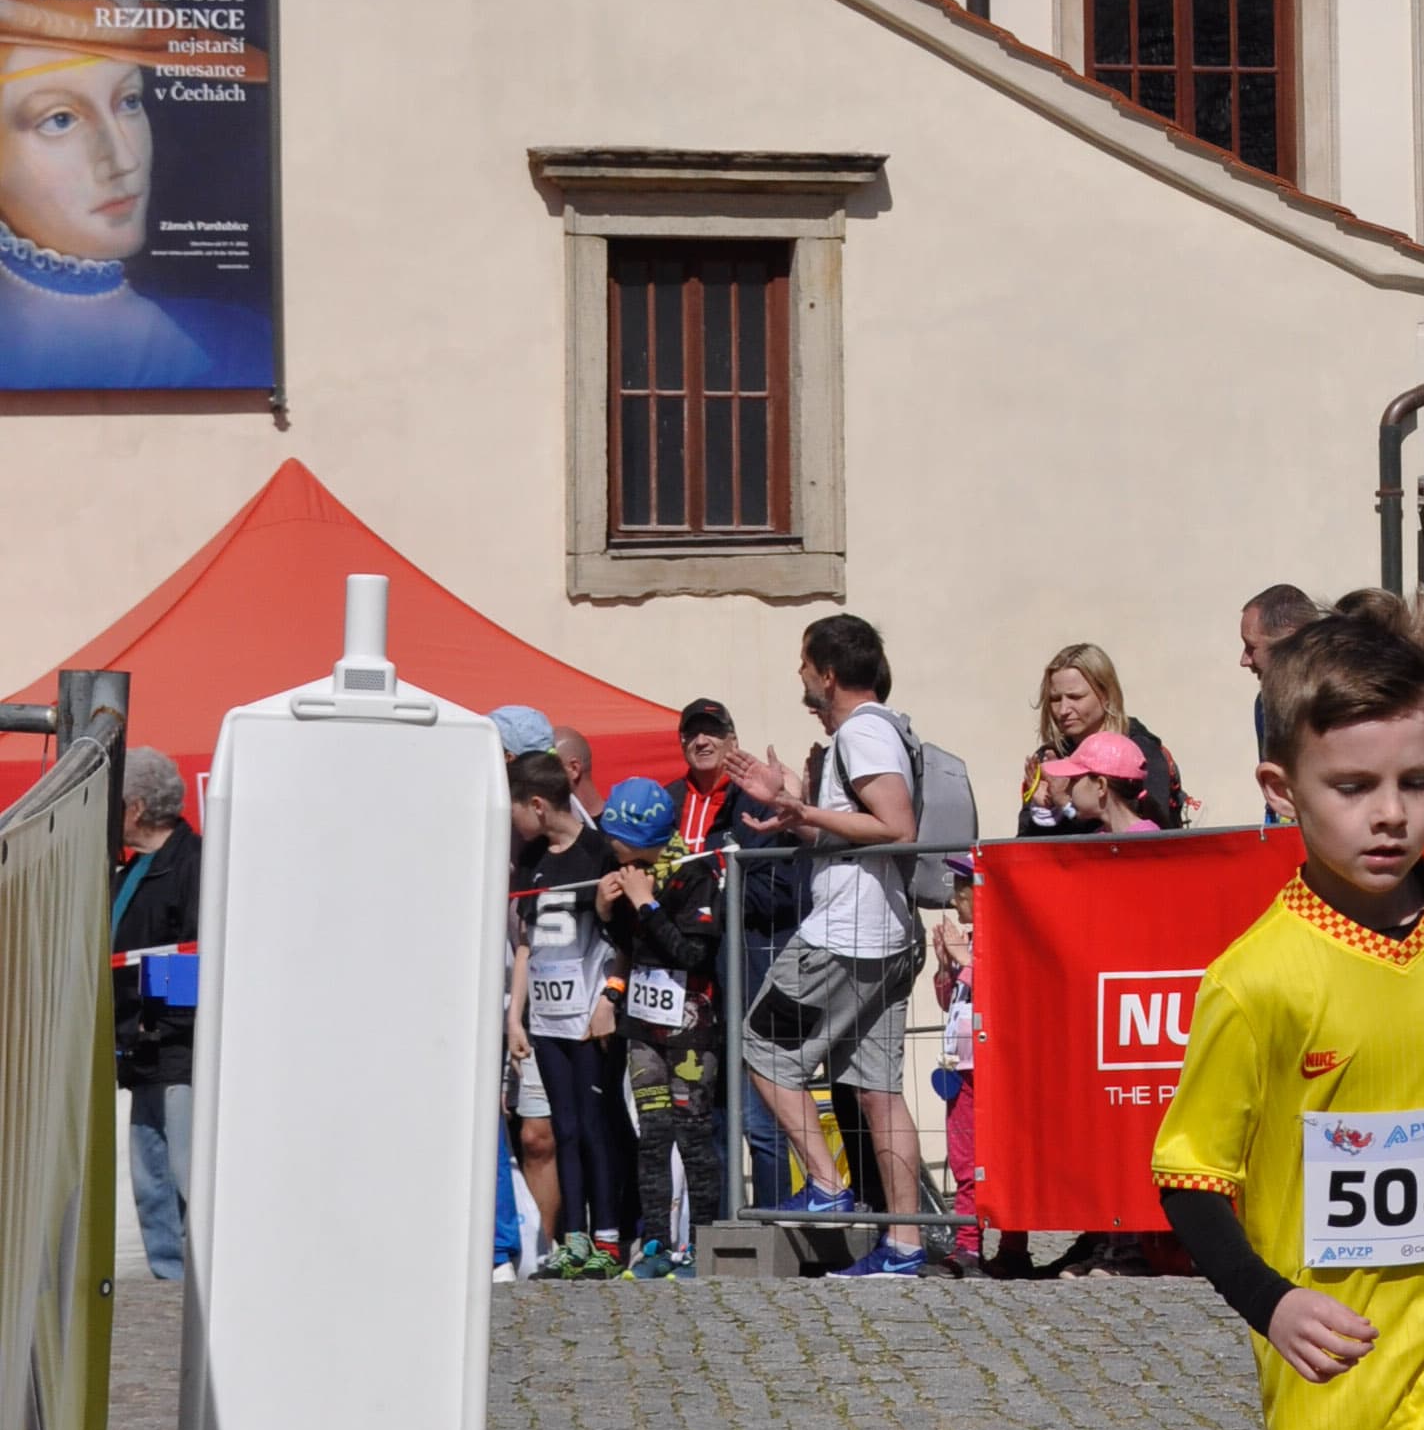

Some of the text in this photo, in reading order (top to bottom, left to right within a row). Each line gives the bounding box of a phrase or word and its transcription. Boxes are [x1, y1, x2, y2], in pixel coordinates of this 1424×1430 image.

[95, 7, 245, 30] REZIDENCE
[168, 37, 245, 56] nejstarší
[155, 64, 245, 78] renesance
[155, 82, 246, 102] v Čechách
[534, 980, 575, 1002] 5107
[633, 983, 674, 1011] 2138
[1305, 1051, 1337, 1068] NIKE
[1104, 1085, 1181, 1106] THE P
[1338, 1246, 1373, 1257] PVZP
